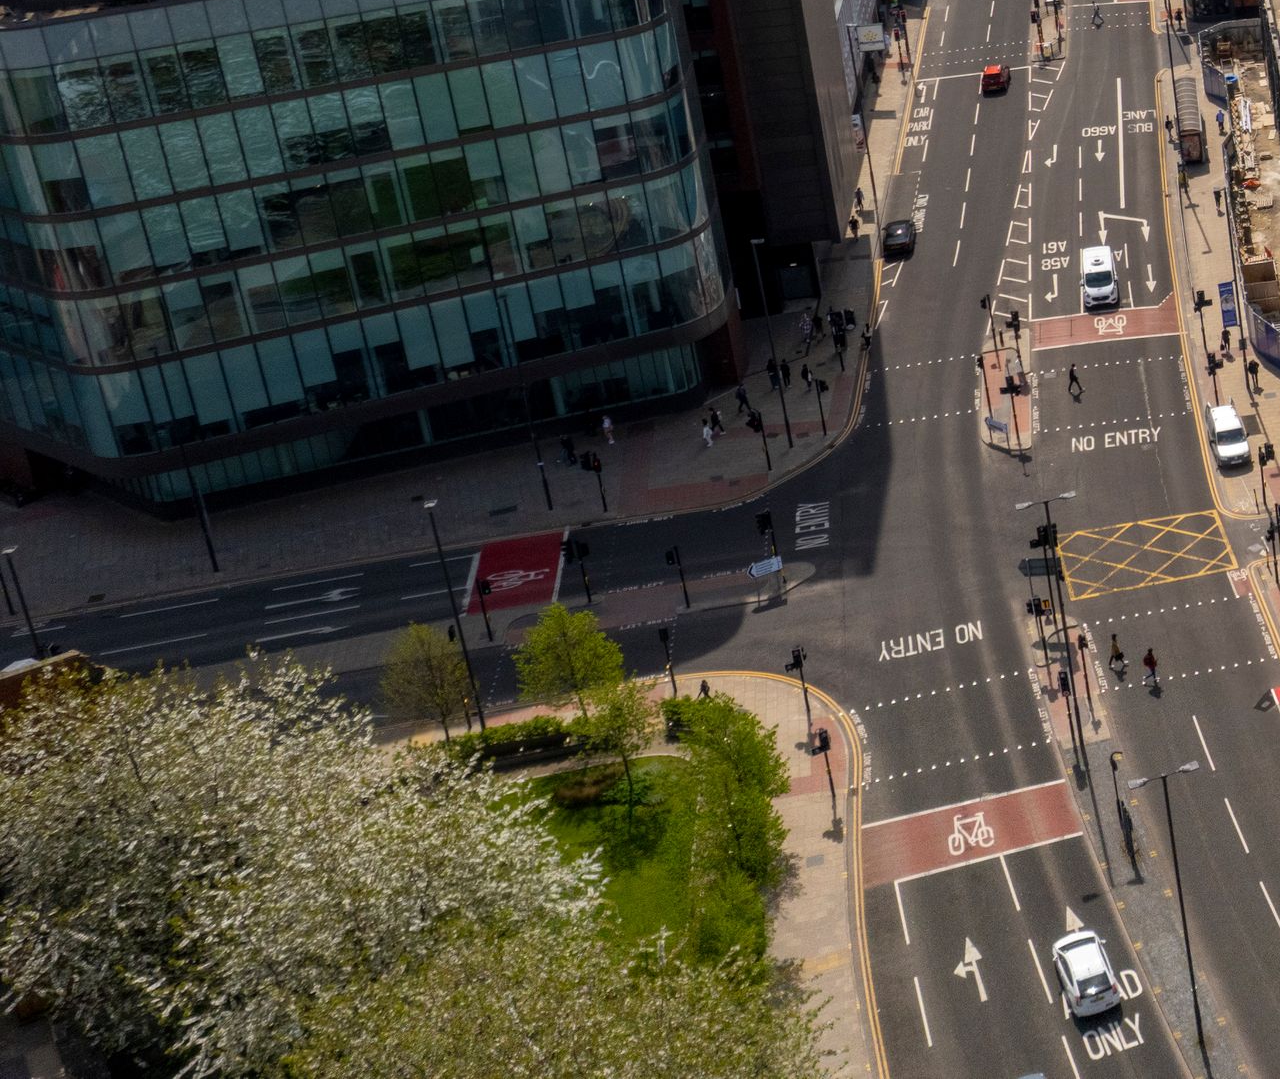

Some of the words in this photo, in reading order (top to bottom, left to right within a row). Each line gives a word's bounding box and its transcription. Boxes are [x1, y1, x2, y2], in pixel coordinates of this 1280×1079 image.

[914, 107, 930, 118] CAR
[1122, 109, 1156, 121] LANE
[908, 122, 929, 132] PARK
[1081, 125, 1117, 137] A660
[1128, 122, 1153, 134] BUS
[904, 135, 928, 147] ONLY
[1042, 241, 1067, 254] A61
[1041, 256, 1070, 271] A58
[1071, 435, 1095, 453] NO
[1104, 426, 1161, 449] ENTRY
[794, 501, 830, 534] ENTRY
[795, 533, 830, 551] NO
[955, 620, 984, 644] NO
[878, 628, 945, 662] ENTRY
[1082, 1012, 1144, 1060] ONLY
